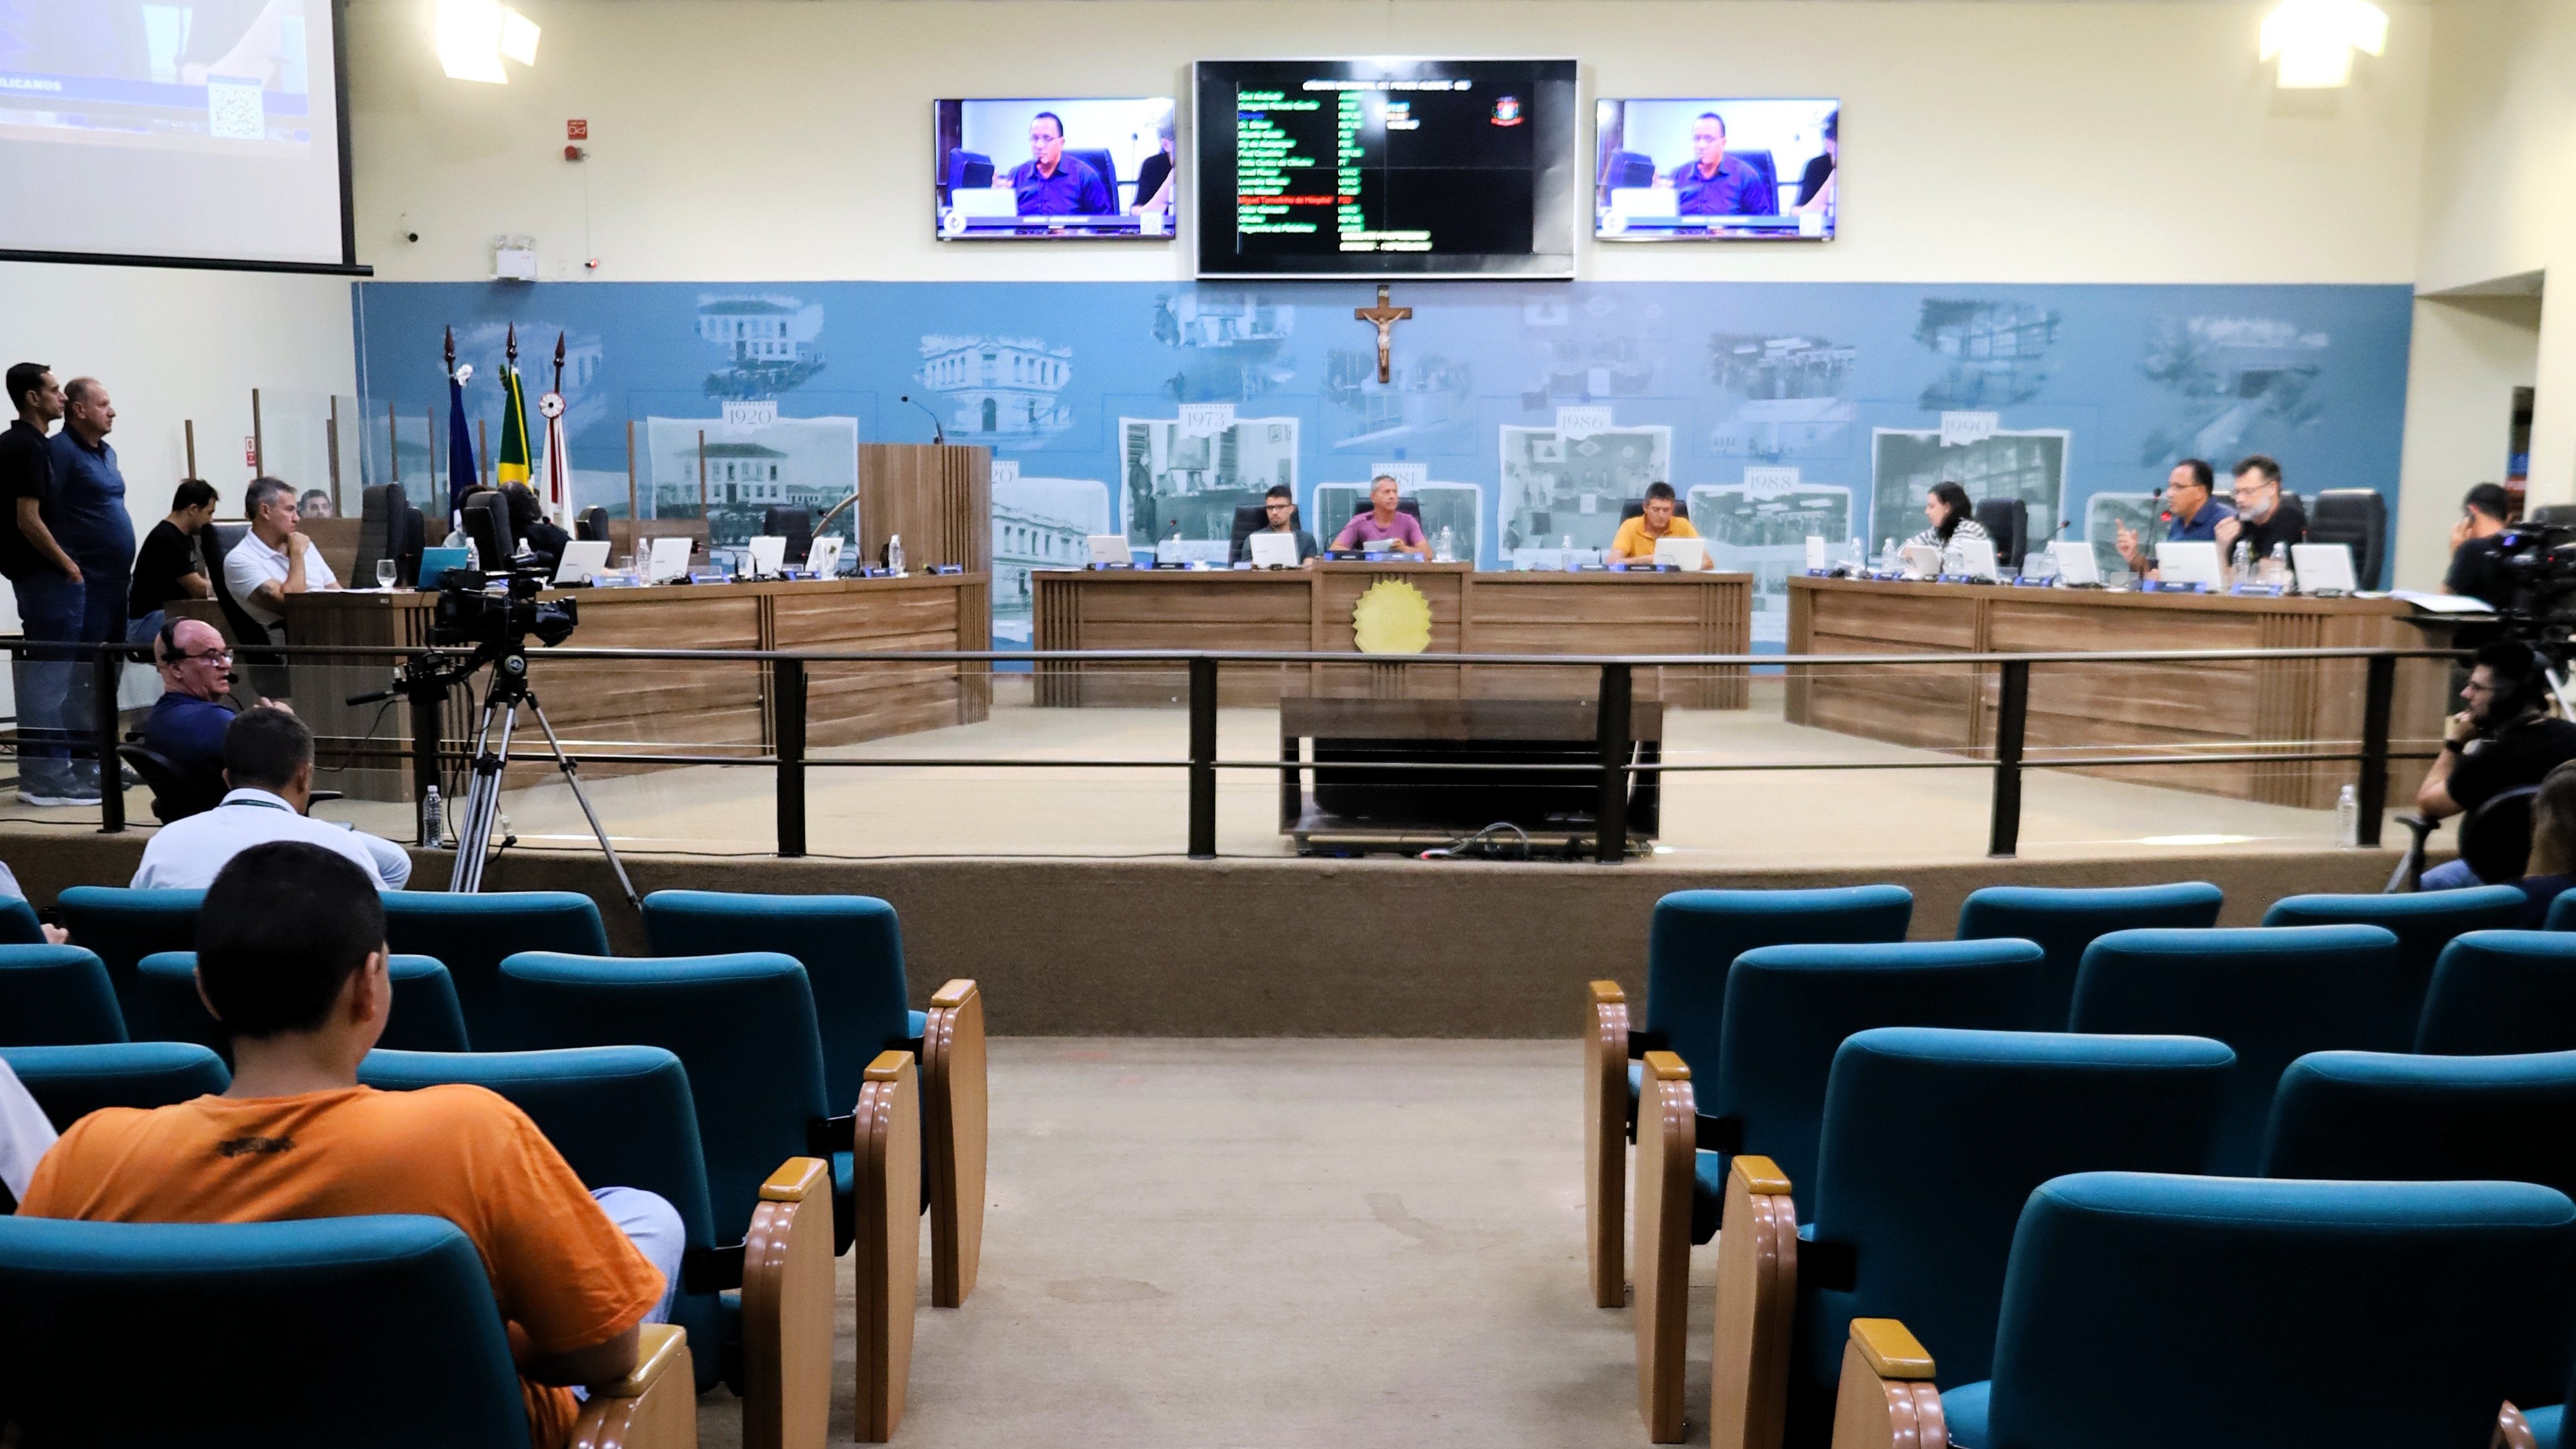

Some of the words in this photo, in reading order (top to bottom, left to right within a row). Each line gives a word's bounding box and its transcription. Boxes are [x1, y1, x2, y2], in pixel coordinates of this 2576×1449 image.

[0, 77, 62, 92] LICANOS
[730, 409, 772, 425] 1920
[1188, 412, 1225, 427] 1973
[1562, 414, 1603, 430] 1986
[1945, 419, 1989, 434] 1990
[1751, 475, 1791, 490] 1988
